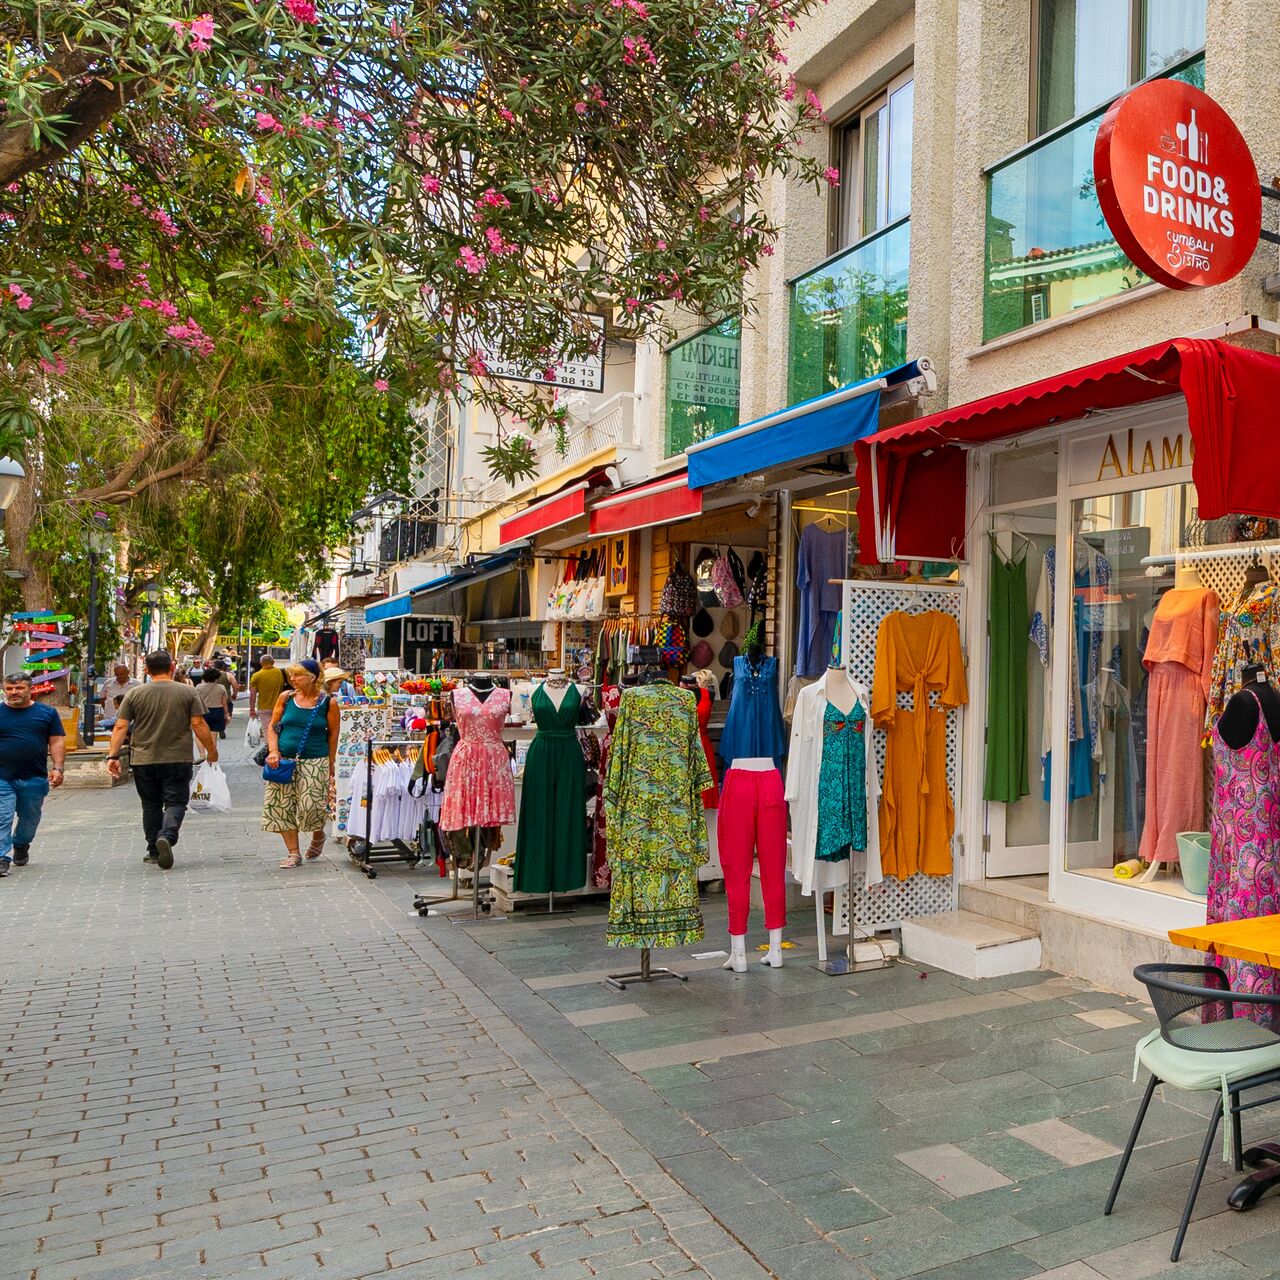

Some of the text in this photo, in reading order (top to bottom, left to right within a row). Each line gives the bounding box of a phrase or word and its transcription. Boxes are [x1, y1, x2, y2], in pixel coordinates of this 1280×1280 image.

[1147, 153, 1229, 206] FOOD&
[1143, 185, 1235, 238] DRINKS
[563, 365, 576, 375] 12
[580, 368, 594, 377] 13
[561, 376, 576, 384] 88
[580, 379, 594, 387] 13
[406, 622, 451, 642] LOFT
